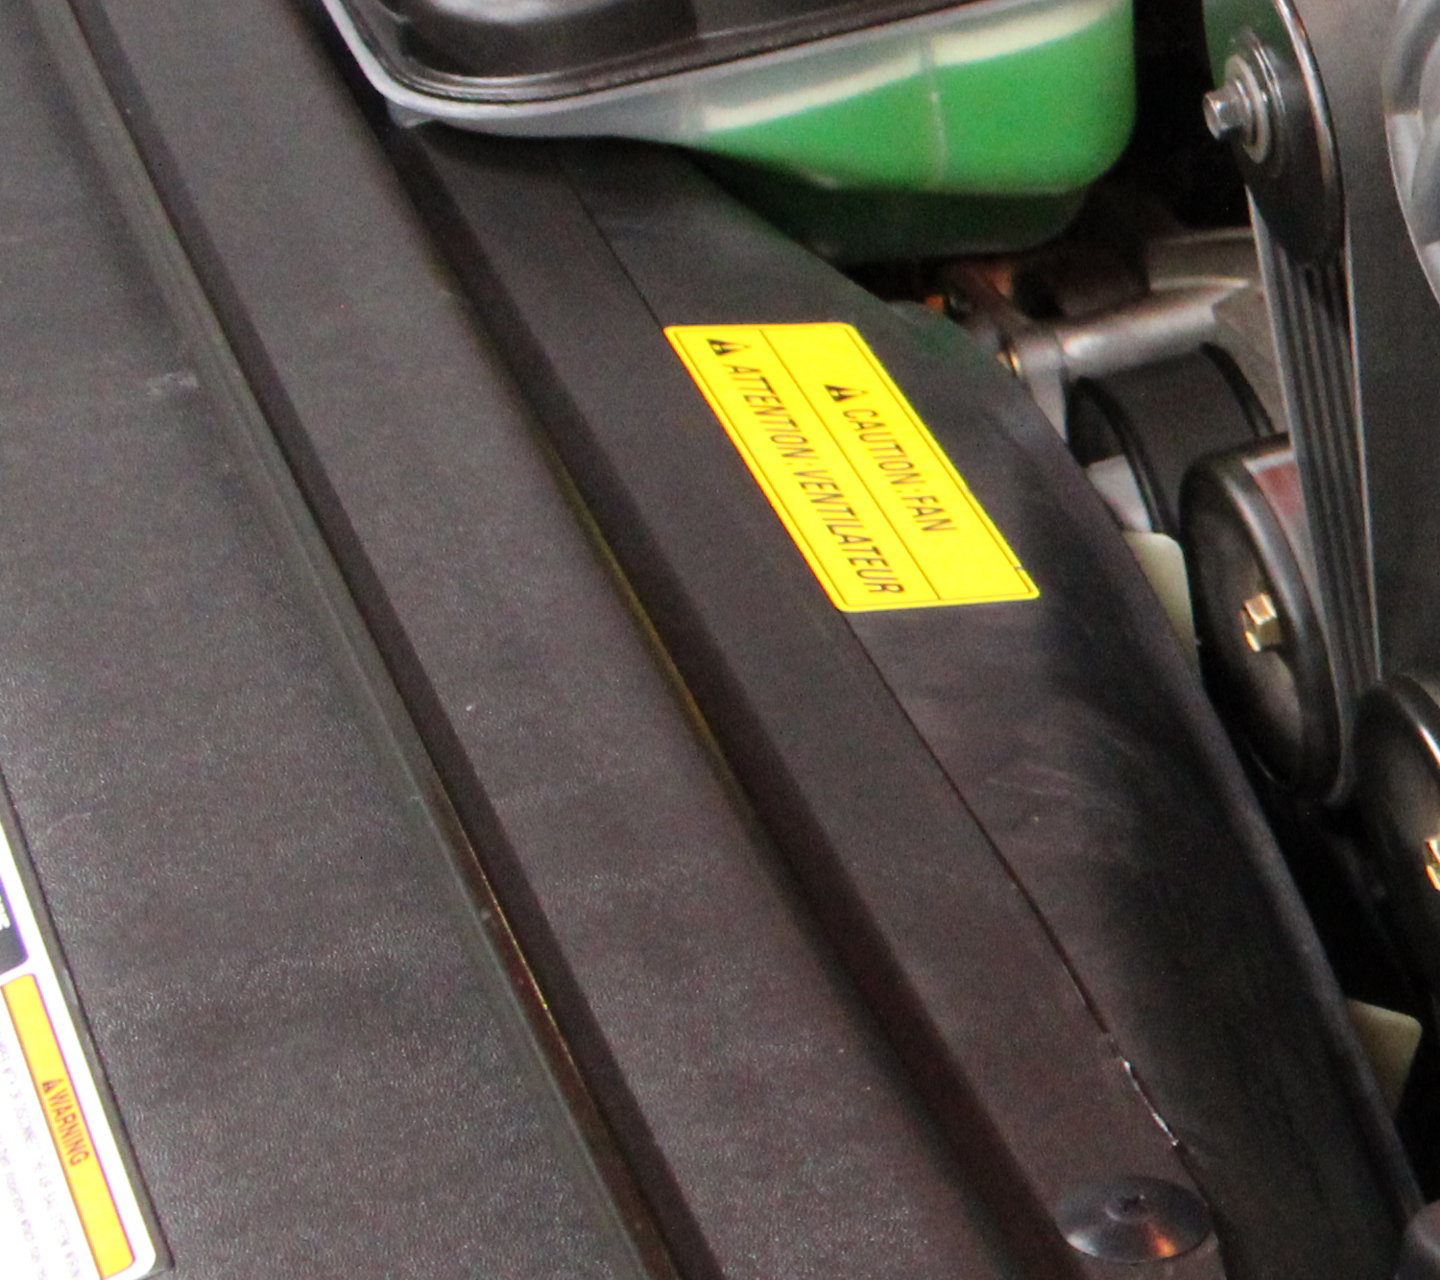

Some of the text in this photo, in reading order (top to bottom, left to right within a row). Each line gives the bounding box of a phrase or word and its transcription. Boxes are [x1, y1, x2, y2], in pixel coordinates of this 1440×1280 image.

[793, 469, 905, 595] VENTILATEUR
[900, 494, 958, 533] FAN
[46, 1086, 92, 1168] WARNING
